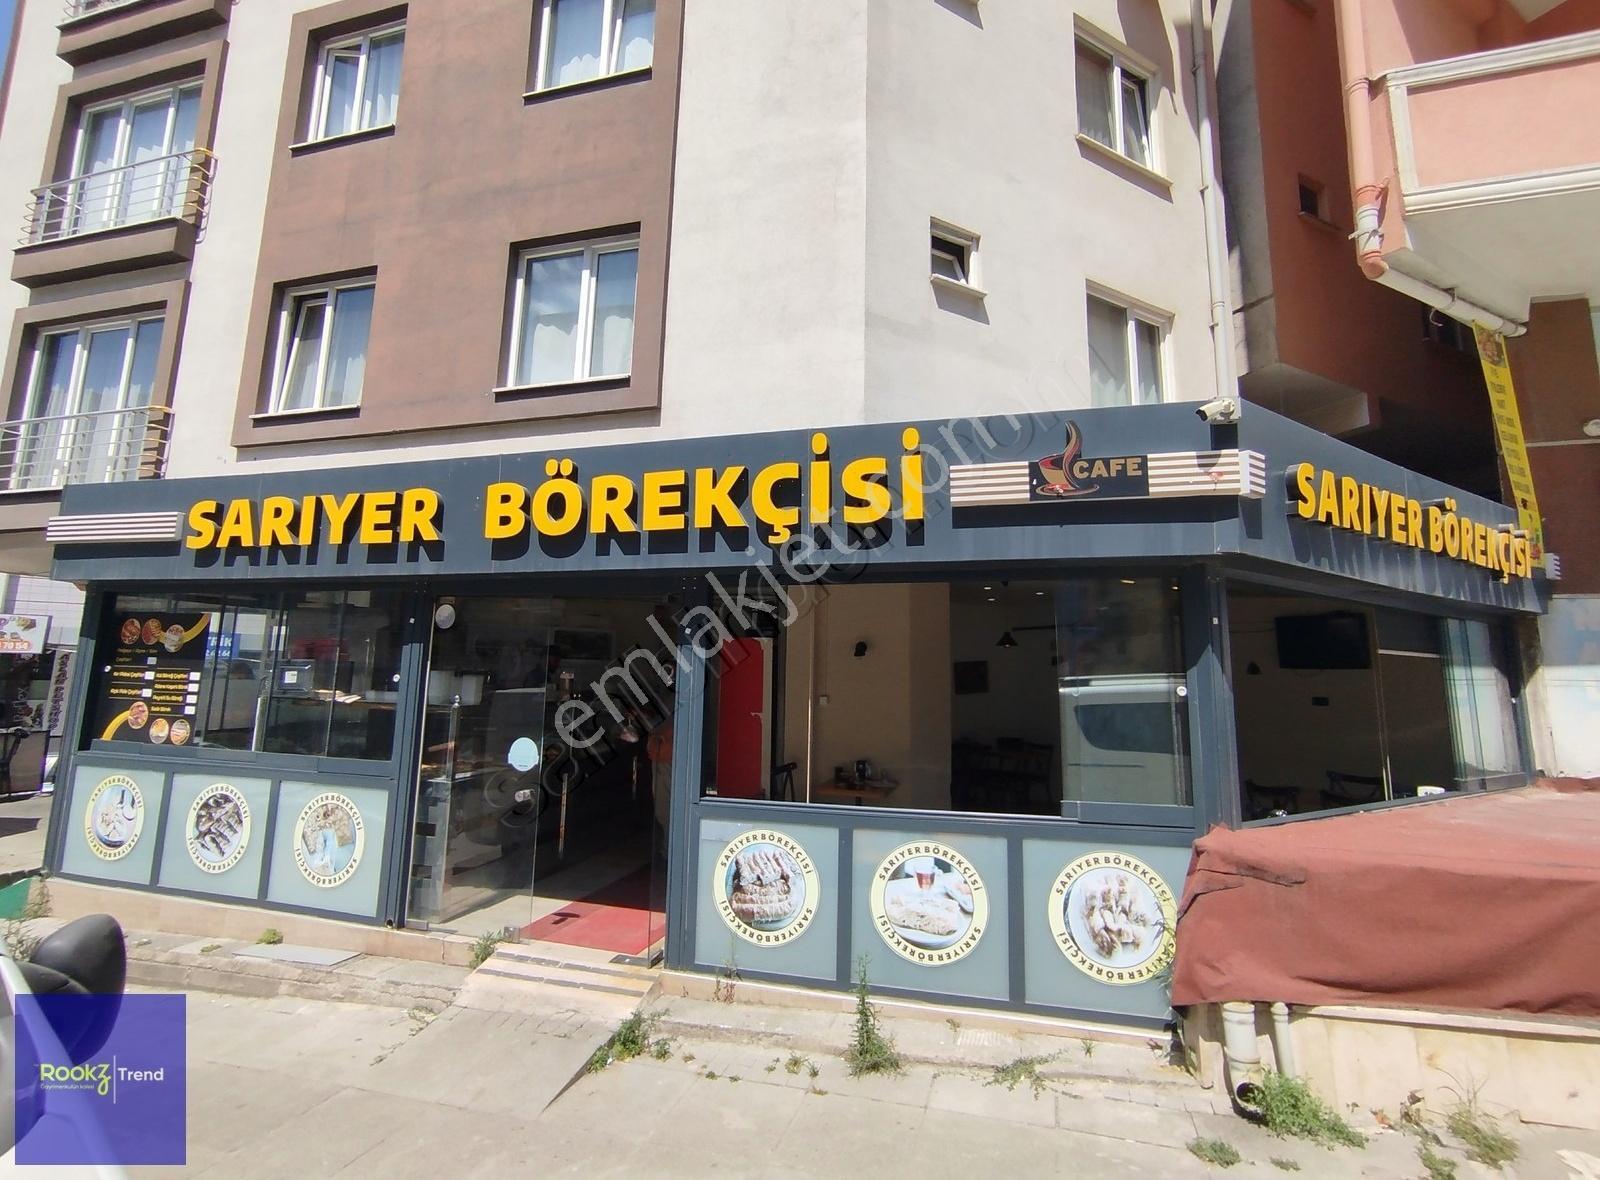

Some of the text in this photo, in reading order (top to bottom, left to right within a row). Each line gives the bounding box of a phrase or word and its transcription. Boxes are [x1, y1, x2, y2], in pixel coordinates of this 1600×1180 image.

[186, 427, 925, 549] SARIYER BÖREKÇİSİ
[1072, 457, 1142, 479] CAFE
[1297, 462, 1531, 584] SARIYER BÖREKÇİSİ
